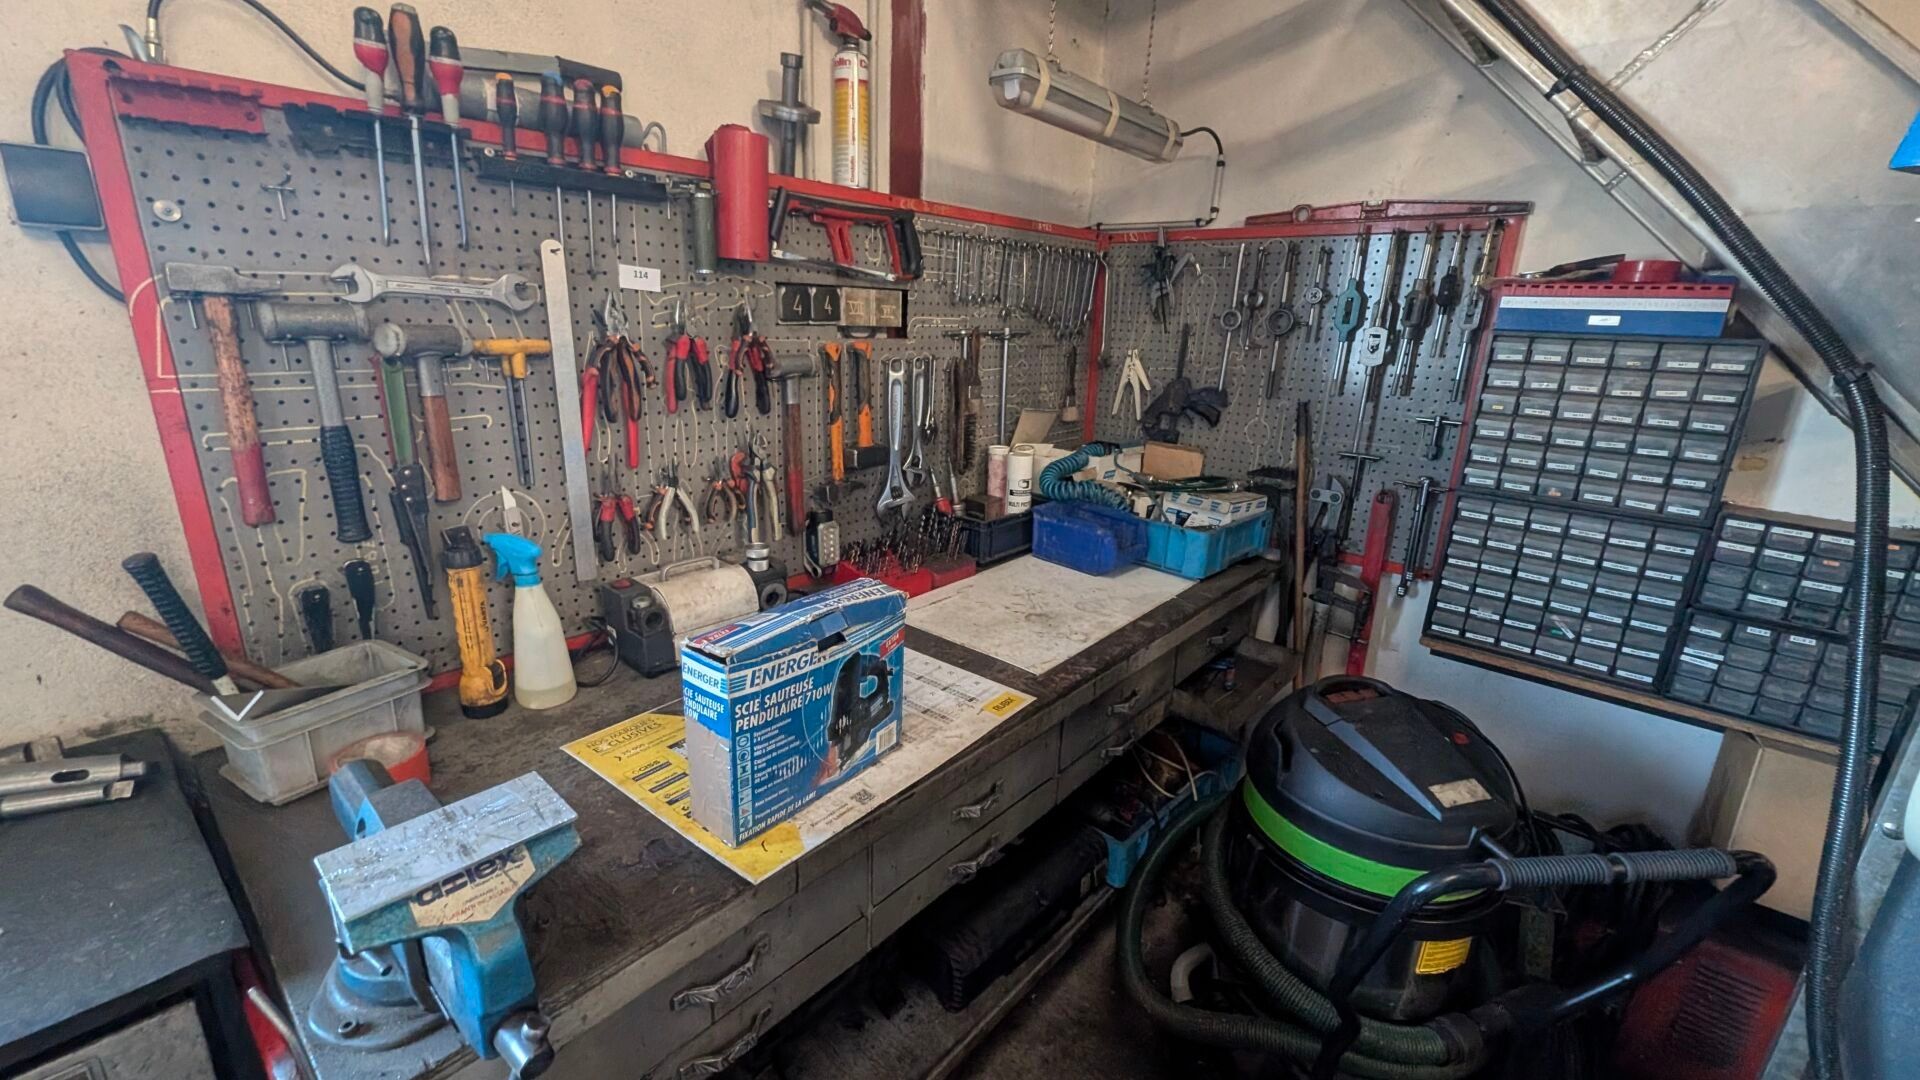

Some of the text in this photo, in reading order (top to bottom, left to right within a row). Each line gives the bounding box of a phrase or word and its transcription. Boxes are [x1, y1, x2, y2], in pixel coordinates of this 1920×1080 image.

[633, 270, 648, 279] 114
[793, 294, 802, 315] 4
[824, 295, 832, 315] 4
[682, 662, 720, 689] ENERGER
[683, 686, 725, 713] CIE SAUTEUSE
[684, 696, 718, 721] ENDULAIRE
[734, 676, 814, 718] SCIE SAUTEUSE
[735, 695, 803, 733] PENDULAIRE
[805, 682, 832, 705] 710W
[684, 705, 699, 720] 10W
[739, 822, 766, 841] FIXATION
[767, 808, 787, 826] RAPIDE
[787, 805, 794, 813] DE
[795, 799, 802, 808] LA
